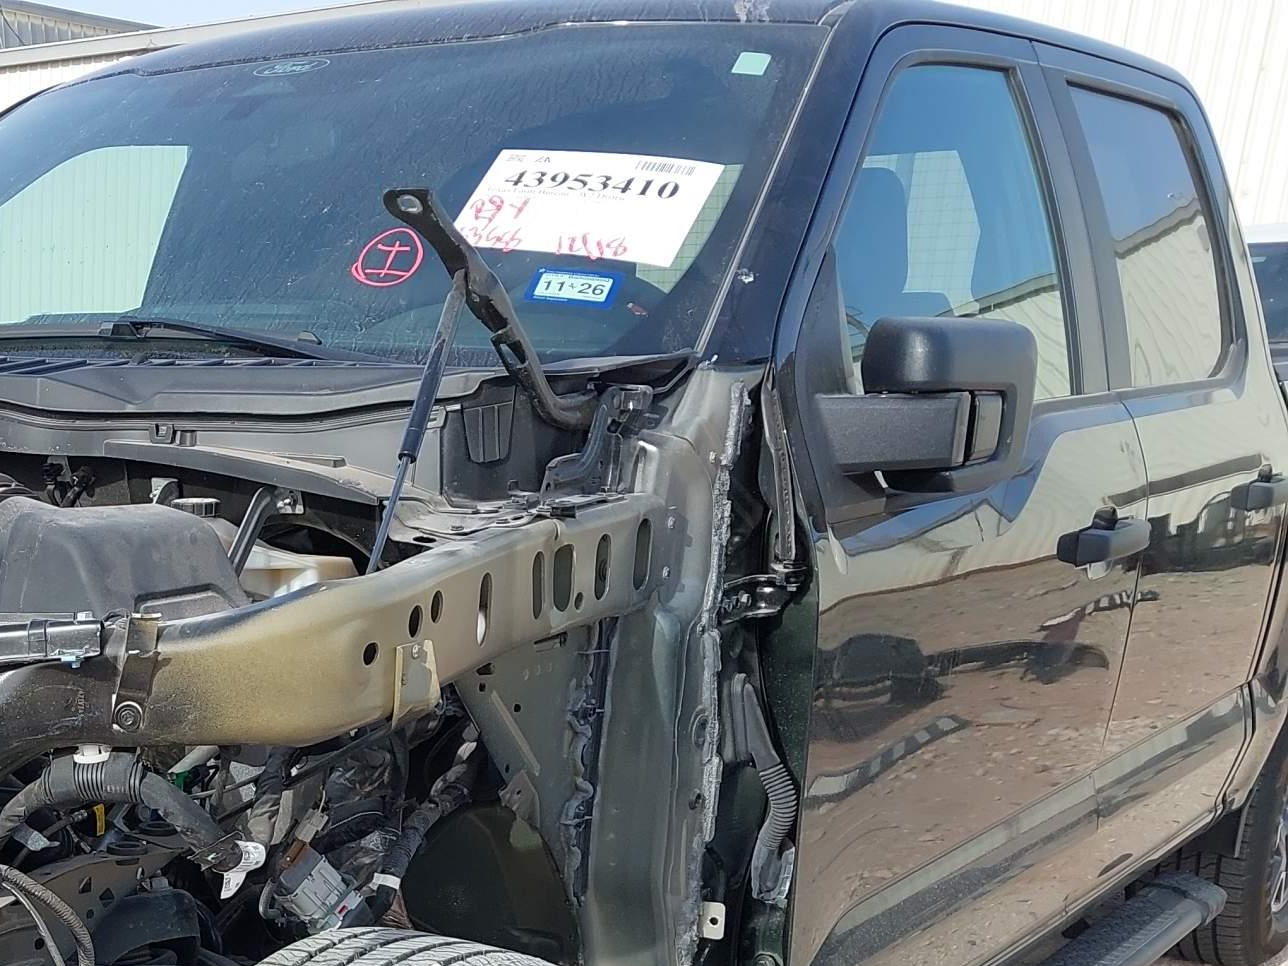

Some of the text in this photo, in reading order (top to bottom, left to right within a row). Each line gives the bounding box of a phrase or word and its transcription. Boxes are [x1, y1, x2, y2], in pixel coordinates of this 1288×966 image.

[259, 60, 324, 75] Ford
[503, 169, 682, 200] 43953410
[543, 279, 566, 293] 11
[577, 282, 606, 296] 26
